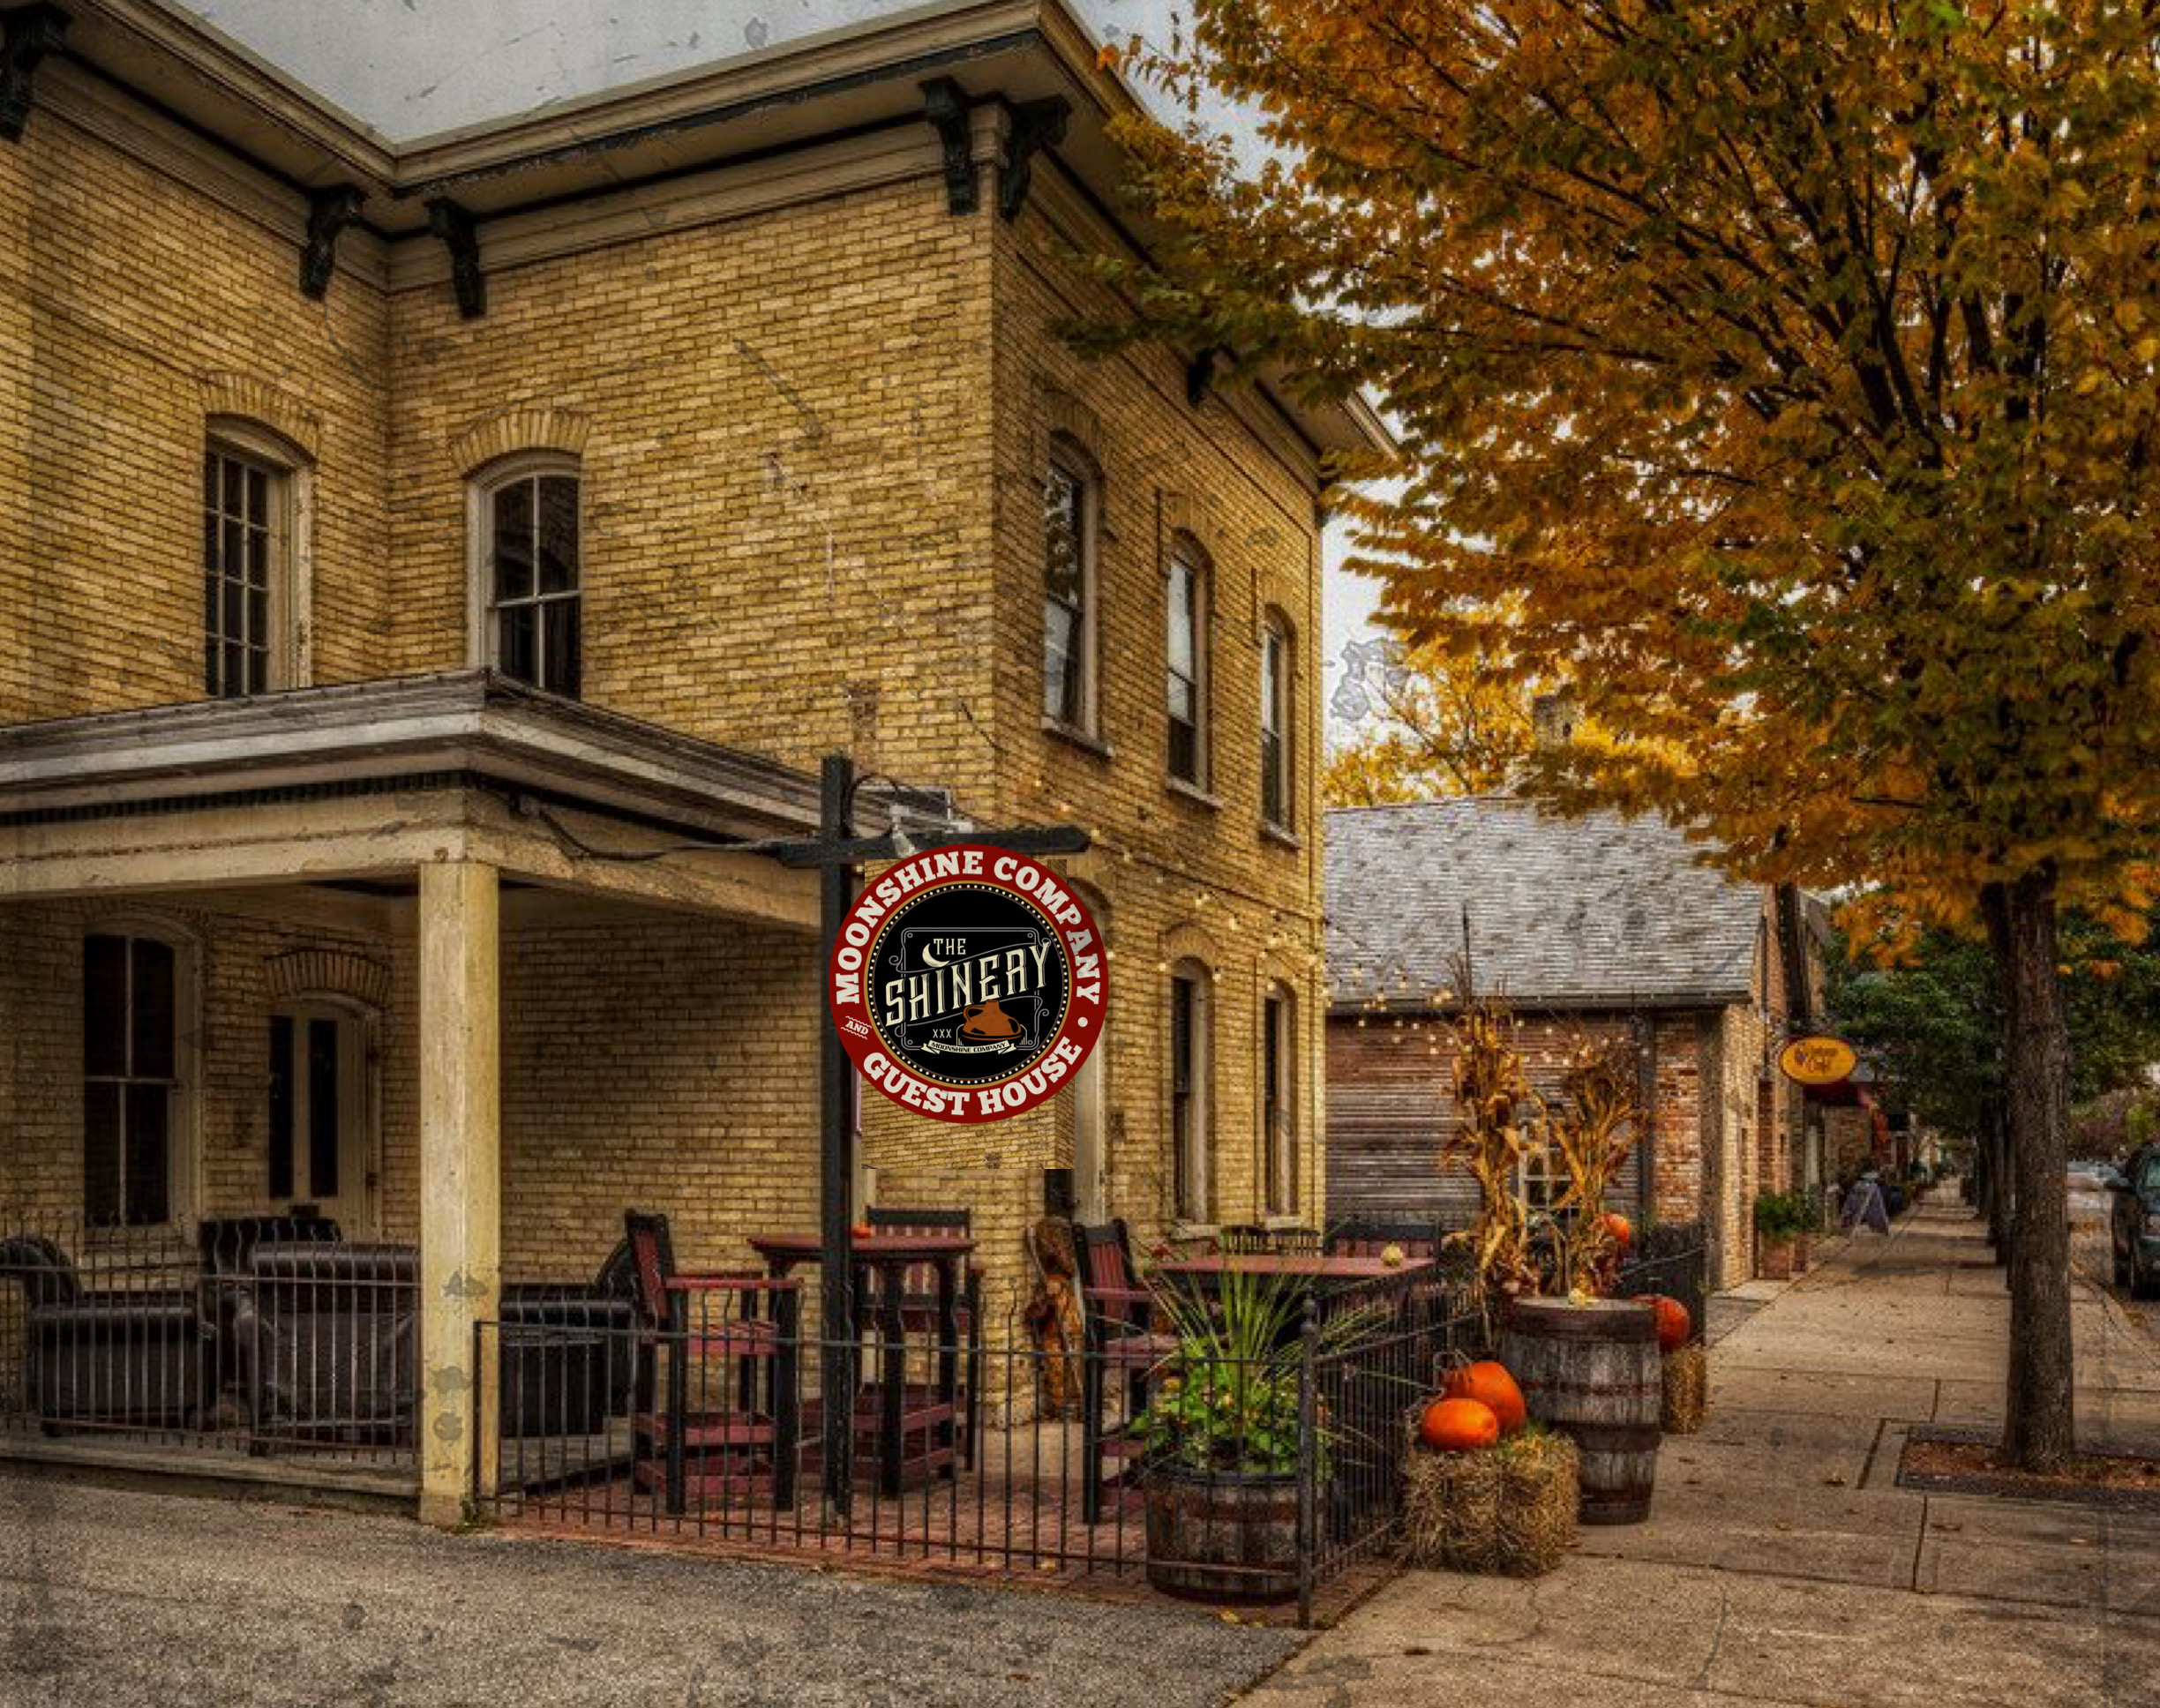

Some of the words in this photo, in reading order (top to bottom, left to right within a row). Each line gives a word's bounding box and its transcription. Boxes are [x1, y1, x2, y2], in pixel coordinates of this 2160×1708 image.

[835, 850, 984, 1005] MOONSHINE
[994, 856, 1101, 1005] COMPANY
[933, 938, 966, 955] THE
[885, 941, 1050, 1027] SHINERY
[844, 1020, 869, 1035] AND
[933, 1029, 952, 1038] XXX
[931, 1042, 971, 1053] MOONSHINE
[973, 1042, 1006, 1053] COMPANY
[863, 1052, 971, 1116] GUEST
[977, 1036, 1084, 1116] HOUSE
